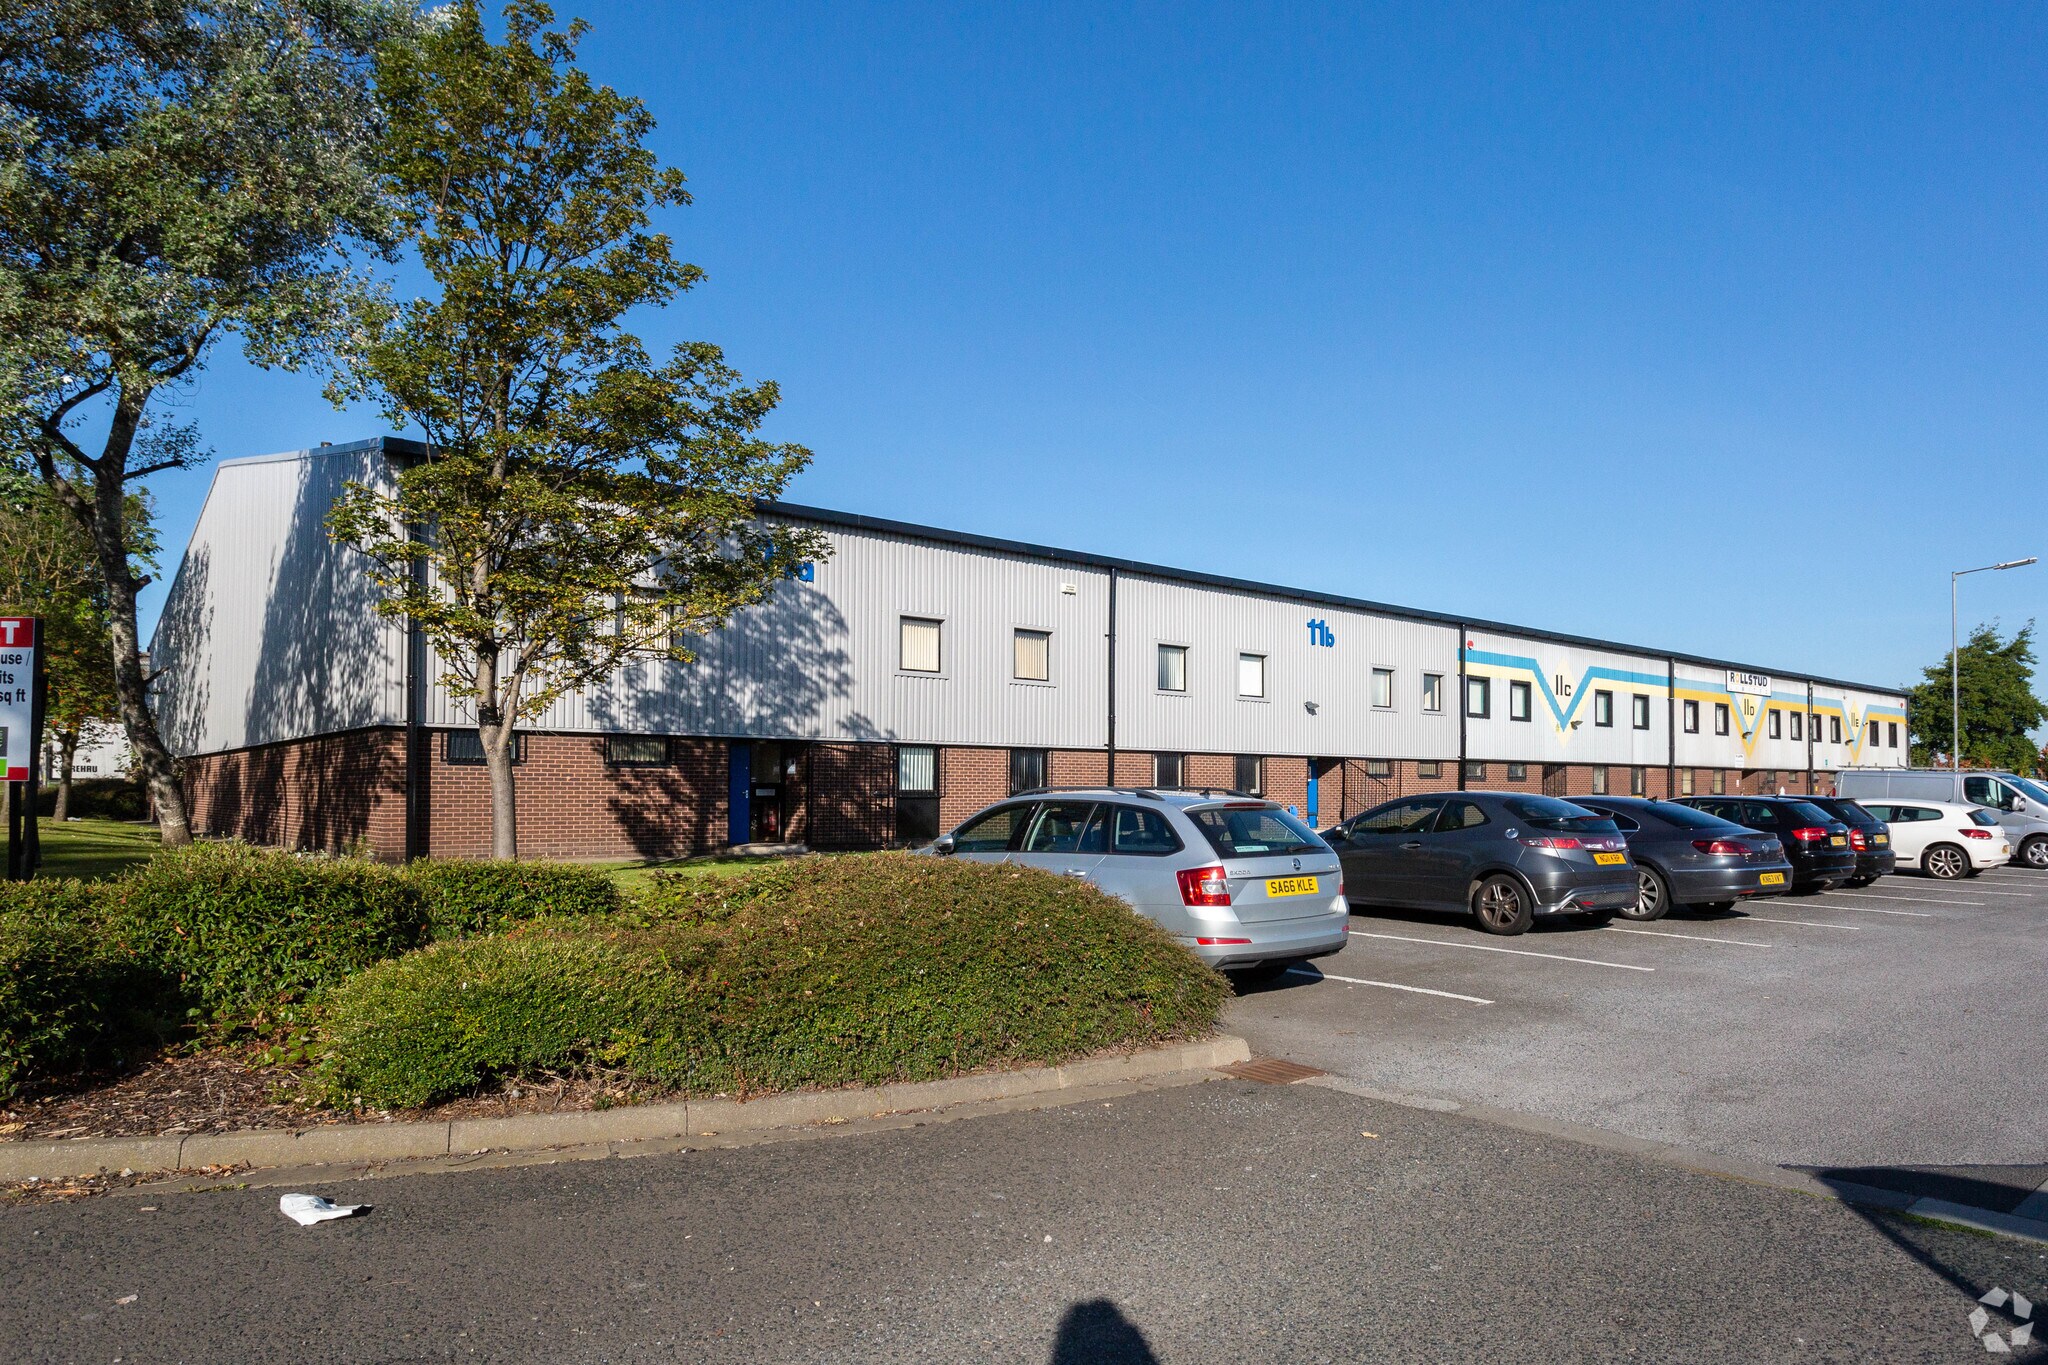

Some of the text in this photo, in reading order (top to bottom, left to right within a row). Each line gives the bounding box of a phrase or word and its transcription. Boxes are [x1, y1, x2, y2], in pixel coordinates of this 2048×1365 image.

[1307, 618, 1335, 648] 11b
[1730, 672, 1768, 687] ROLLSTUD
[16, 688, 26, 702] ft
[1270, 878, 1315, 894] SA66 KLE
